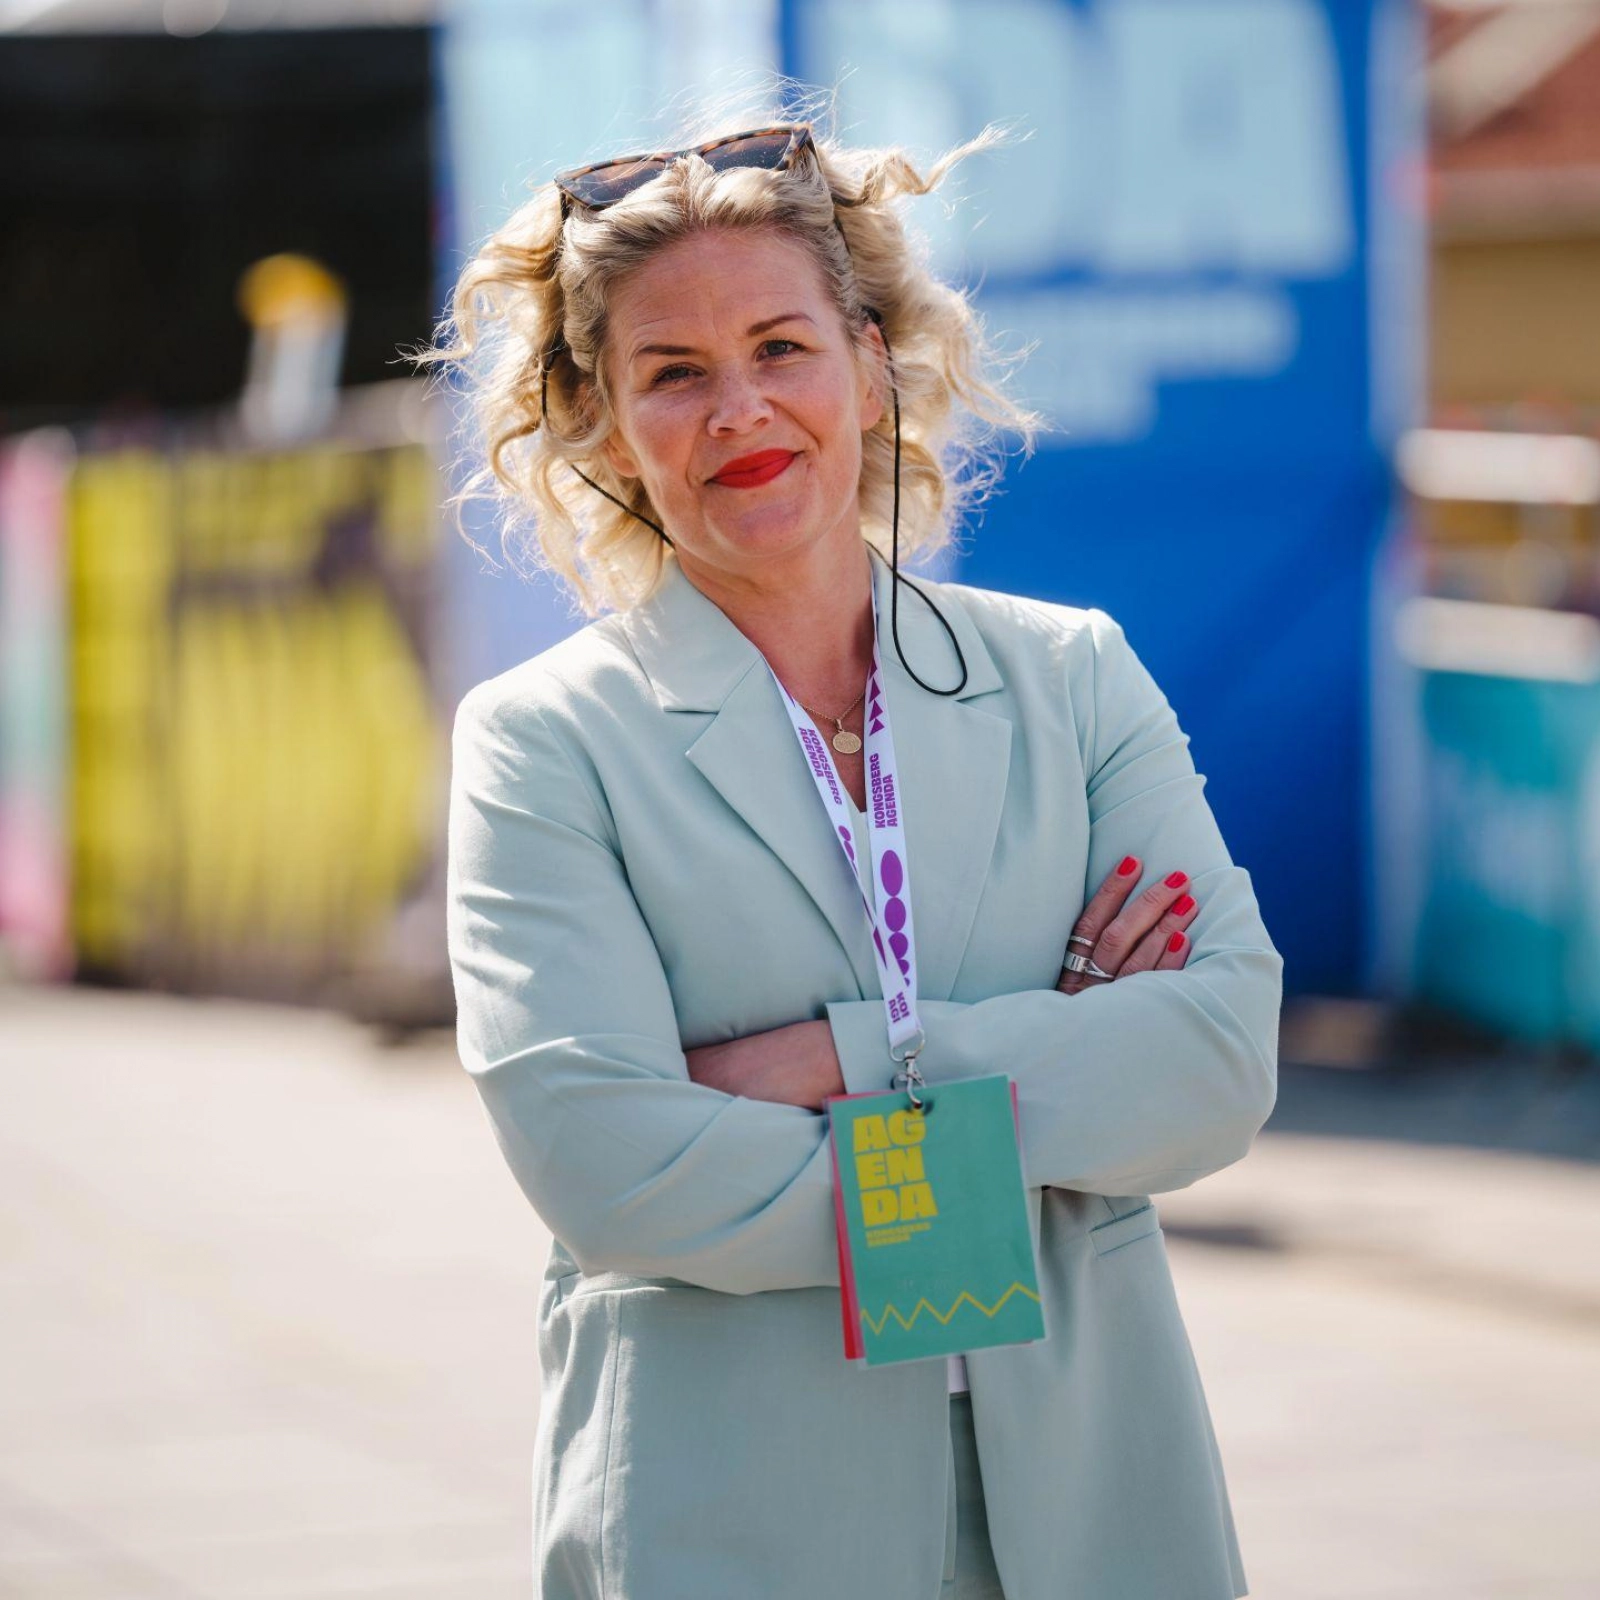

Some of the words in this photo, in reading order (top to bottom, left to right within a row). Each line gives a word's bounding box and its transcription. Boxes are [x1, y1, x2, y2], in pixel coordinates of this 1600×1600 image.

[798, 726, 825, 778] AGENDA
[807, 728, 843, 806] KONGSBERG
[869, 752, 886, 829] KONGSBERG
[883, 773, 898, 828] AGENDA
[852, 1109, 927, 1154] AG
[855, 1145, 925, 1190] EN
[861, 1181, 939, 1228] DA
